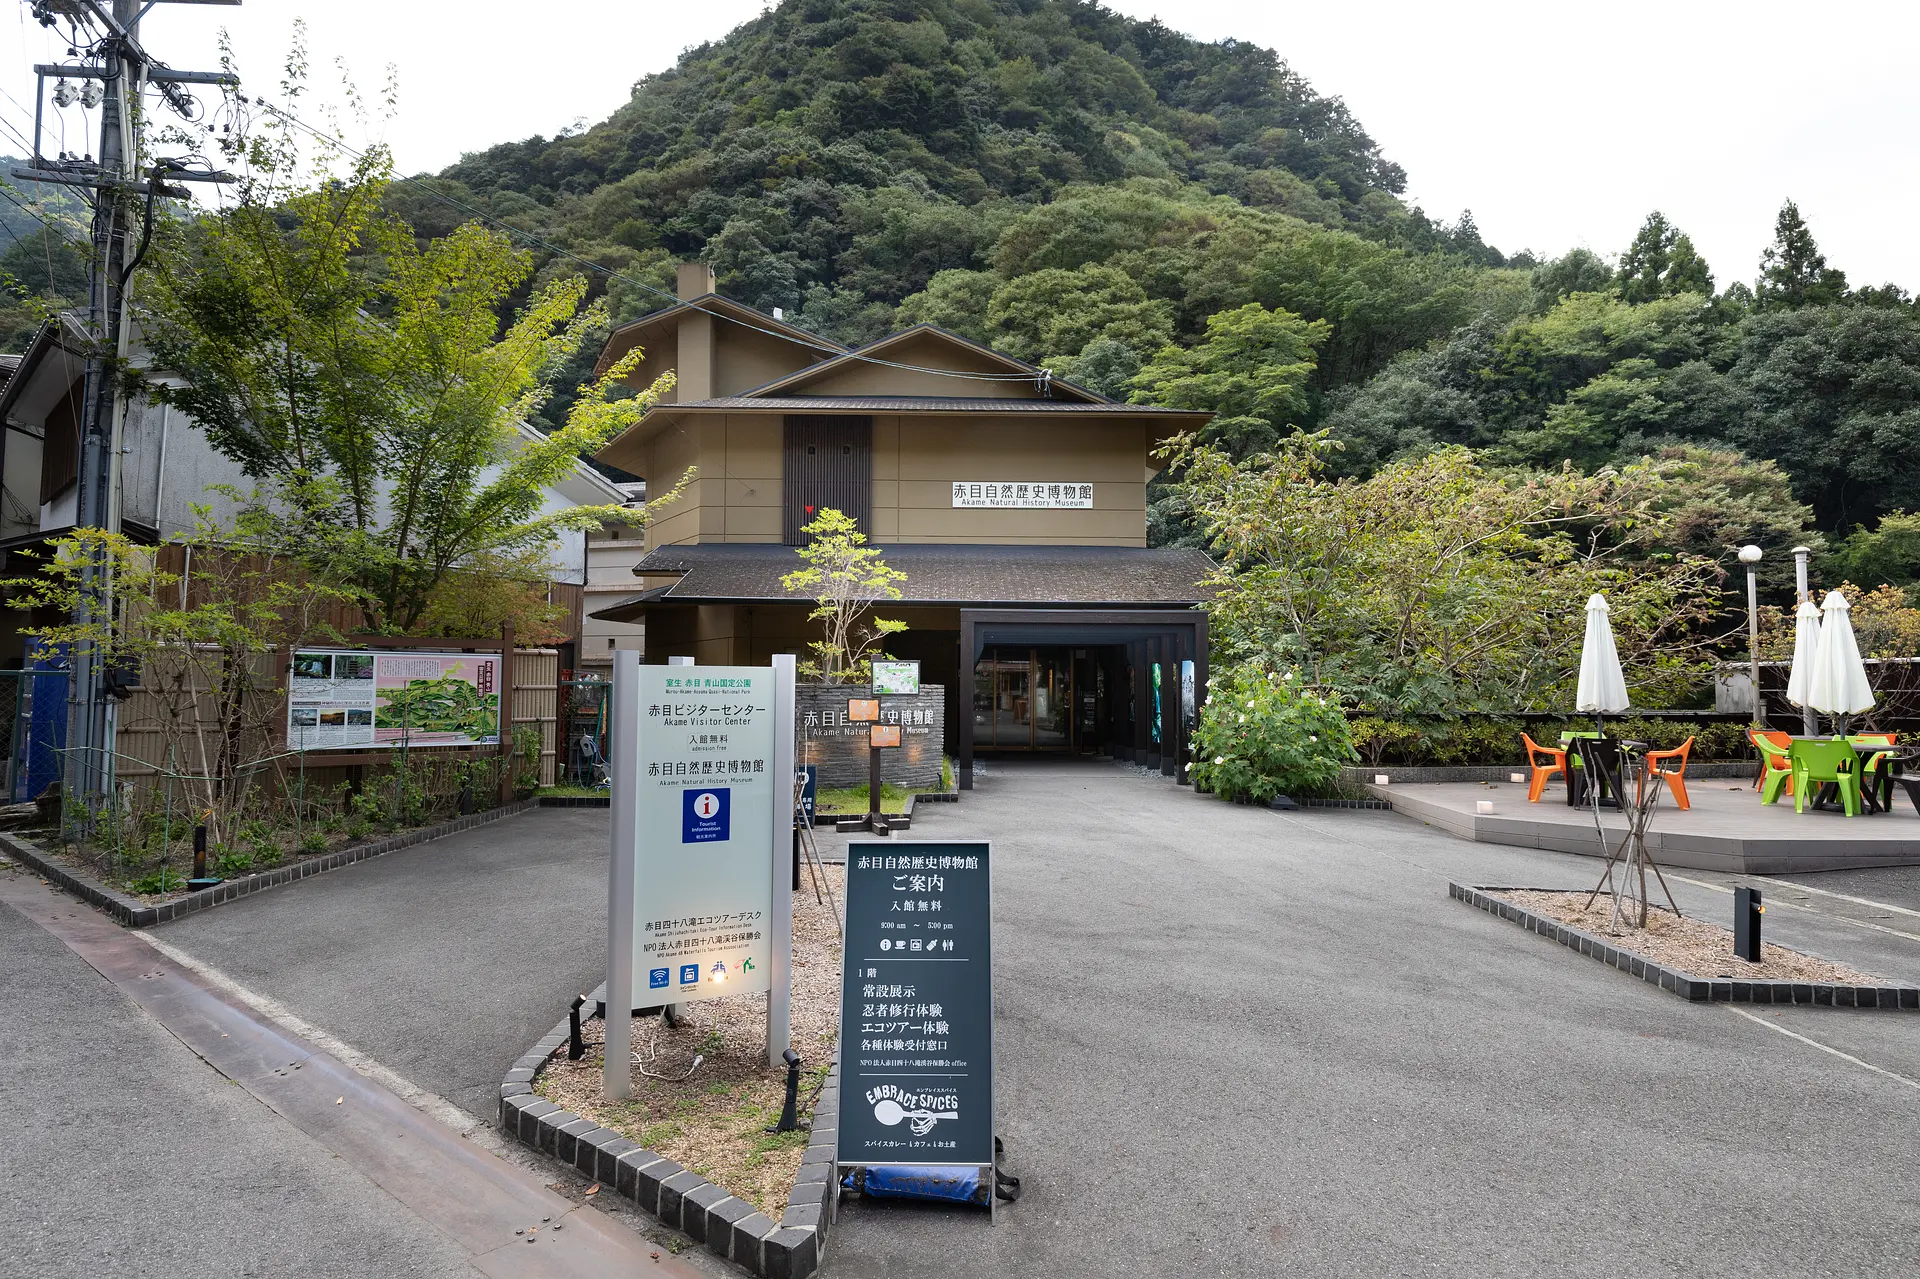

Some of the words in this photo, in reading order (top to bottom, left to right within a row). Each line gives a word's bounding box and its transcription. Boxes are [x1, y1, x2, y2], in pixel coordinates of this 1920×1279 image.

[953, 484, 1092, 499] 赤目自然歴史博物館
[1023, 499, 1050, 508] History
[1055, 499, 1085, 507] Museum
[665, 678, 682, 687] 室生
[685, 678, 700, 687] 赤目
[704, 678, 751, 688] 青山国定公園
[648, 703, 766, 717] 赤目ビジターセンター
[664, 717, 688, 726] Akame
[690, 717, 722, 726] Visitor
[724, 717, 751, 726] Center
[689, 734, 728, 744] 入館無料
[812, 728, 840, 736] Akame
[648, 759, 764, 776] 赤目自然歴史博物館
[857, 855, 979, 870] 赤目自然歴史博物館
[892, 874, 944, 892] ご案内
[890, 900, 942, 912] 入館無料
[880, 921, 895, 929] 9:00
[927, 921, 942, 929] 5:00
[862, 984, 916, 998] 常設展示
[862, 1003, 943, 1017] 忍者修行体験
[861, 1021, 950, 1035] エコツアー体験
[860, 1039, 948, 1051] 各種体験受付窓口
[865, 1084, 918, 1109] EMBRACE
[919, 1093, 959, 1110] SPICES
